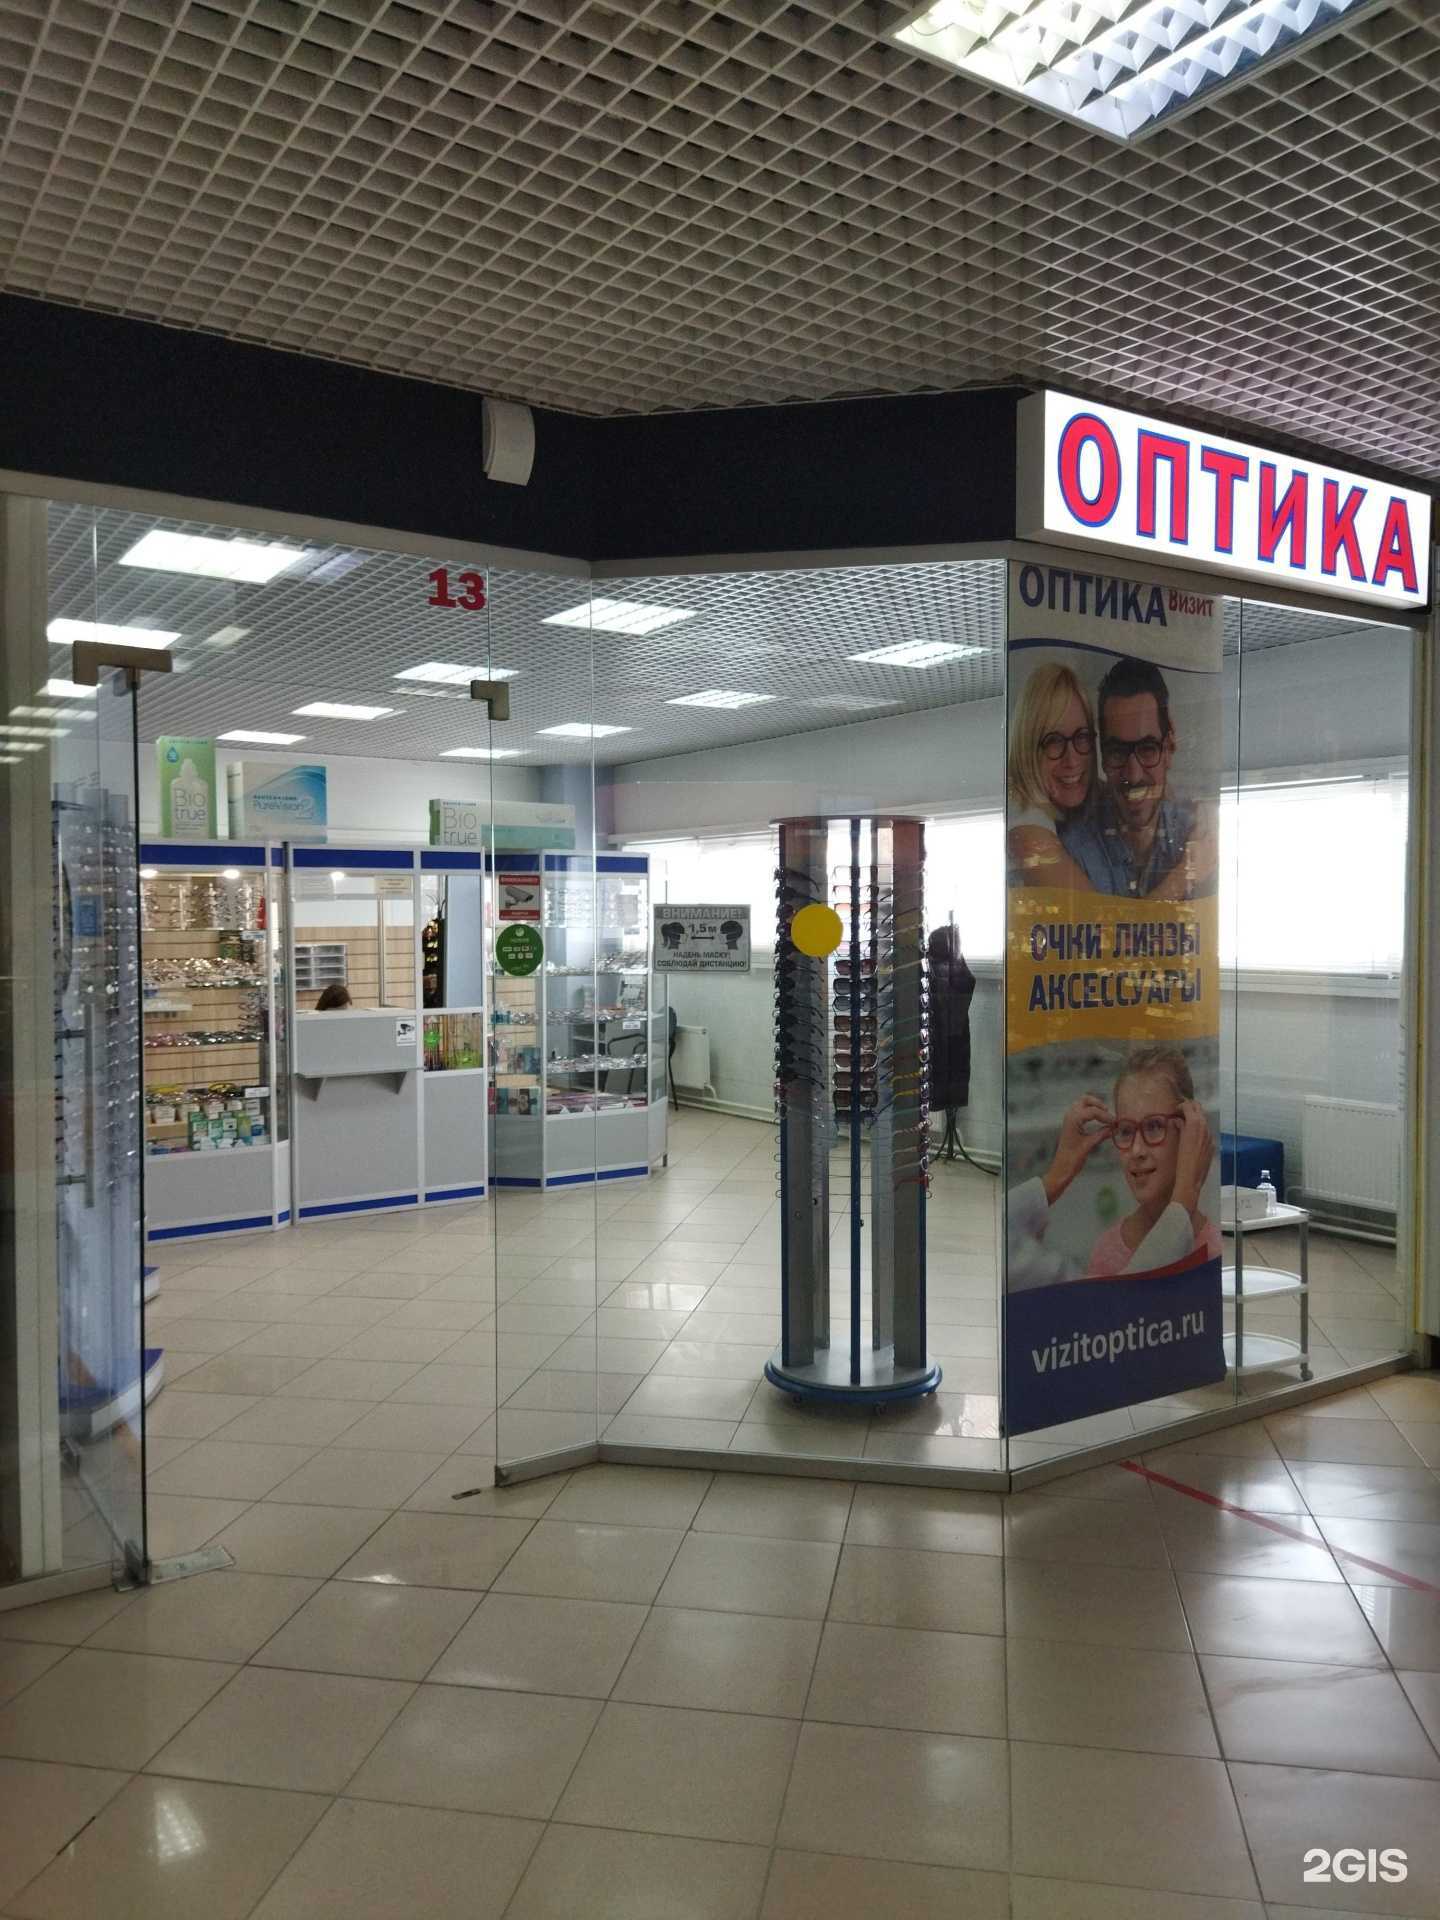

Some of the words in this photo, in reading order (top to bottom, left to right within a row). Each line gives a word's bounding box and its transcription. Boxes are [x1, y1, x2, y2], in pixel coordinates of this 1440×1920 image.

[1057, 412, 1419, 594] ОПТИКА
[428, 567, 486, 611] 13
[1019, 564, 1168, 627] ОПТИКА
[688, 923, 707, 934] 1,5
[1030, 924, 1102, 962] ОЧКИ
[1112, 922, 1200, 959] ЛИНЗЫ
[1028, 967, 1201, 1012] АКСЕССУАРЫ
[1031, 1310, 1205, 1373] vizitoptica.ru
